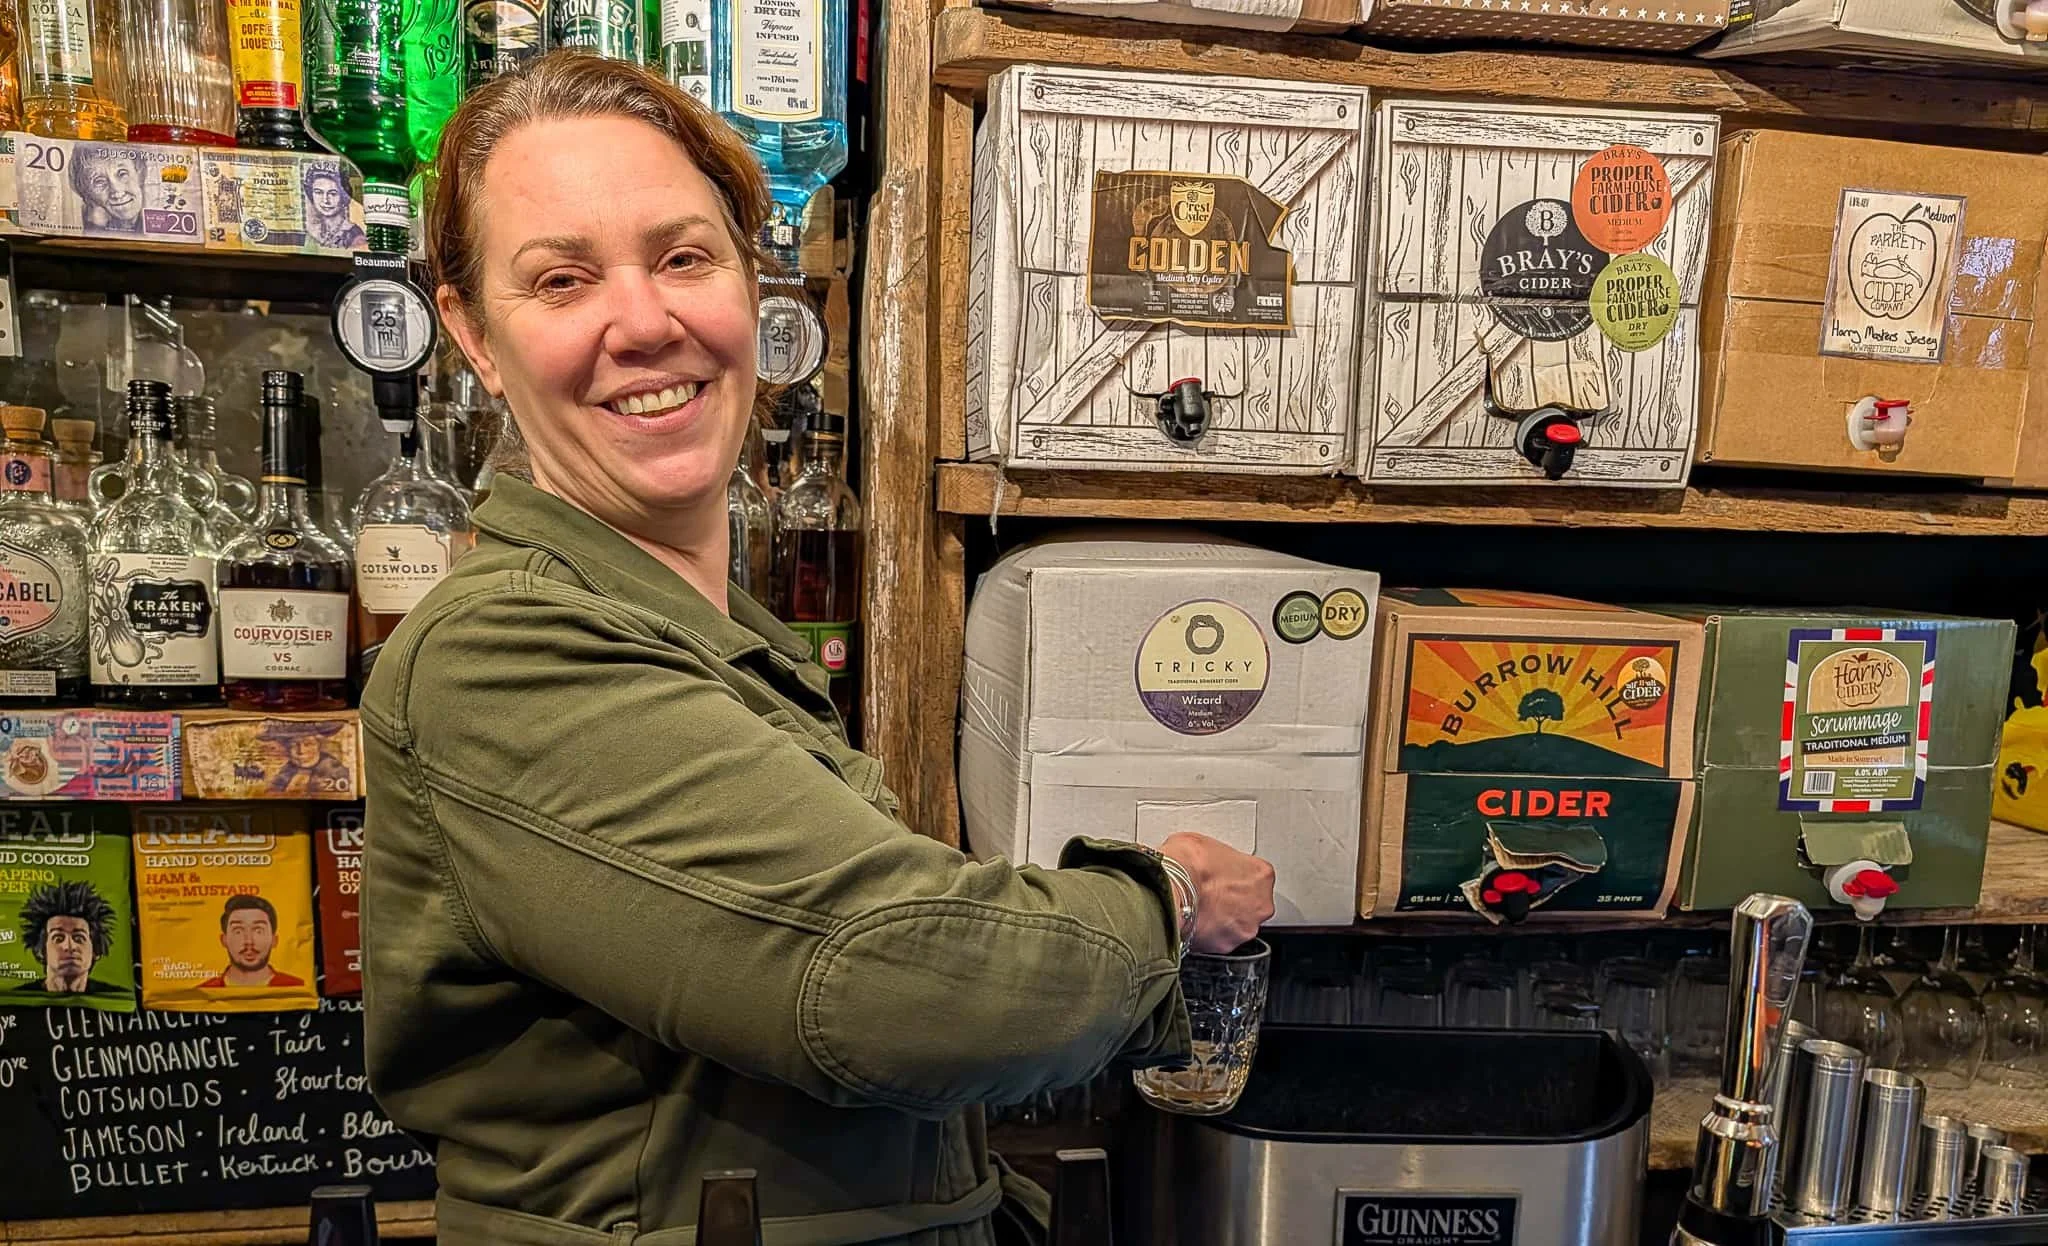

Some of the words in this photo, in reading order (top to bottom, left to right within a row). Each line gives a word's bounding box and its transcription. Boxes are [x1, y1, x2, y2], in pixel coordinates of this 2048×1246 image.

[754, 6, 777, 16] DRY
[778, 7, 801, 17] GIN
[756, 31, 800, 42] INFUSED
[771, 75, 785, 84] 1761
[23, 143, 65, 173] 20
[97, 148, 138, 162] TJUGO
[140, 151, 194, 165] KRONOR
[1603, 148, 1642, 161] BRAY'S
[1591, 165, 1655, 183] PROPER
[1591, 180, 1663, 195] FARMHOUSE
[1589, 192, 1651, 216] CIDER
[1541, 210, 1555, 232] B
[1606, 217, 1644, 227] MEDIUM
[1922, 205, 1957, 224] Medium
[168, 213, 196, 234] 20
[1891, 223, 1907, 233] THE
[209, 227, 225, 242] $2
[1870, 232, 1927, 251] PARRETT
[354, 256, 406, 269] Beaumont
[1128, 236, 1250, 274] GOLDEN
[1496, 248, 1594, 278] BRAY'S
[1615, 262, 1653, 276] BRAY'S
[1155, 273, 1185, 283] Medium
[1185, 274, 1200, 285] Dry
[1200, 275, 1224, 286] Cyder
[1519, 277, 1573, 290] CIDER
[1606, 274, 1663, 294] PROPER
[1606, 286, 1672, 306] FARMHOUSE
[1863, 280, 1914, 303] CIDER
[1606, 299, 1660, 323] CIDER
[1870, 301, 1904, 312] COMPANY
[372, 310, 397, 328] 25
[1628, 321, 1649, 332] DRY
[378, 329, 393, 342] ml
[770, 326, 792, 343] 25
[1832, 319, 1862, 344] Harry
[361, 564, 438, 574] COTSWOLDS
[159, 590, 180, 601] The
[133, 600, 202, 612] KRAKEN
[1324, 605, 1362, 622] DRY
[1279, 612, 1320, 624] MEDIUM
[233, 627, 333, 642] COURVOISIER
[273, 652, 293, 663] VS
[265, 665, 301, 673] COGNAC
[1154, 661, 1253, 673] TRICKY
[1833, 659, 1894, 689] Harry's
[1440, 653, 1574, 737] BURROW
[1580, 667, 1633, 741] HILL
[1622, 686, 1662, 700] CIDER
[1837, 682, 1879, 700] CIDER
[1181, 694, 1222, 705] Wizard
[1187, 709, 1213, 717] Medium
[1811, 710, 1903, 738] Scrummage
[1806, 739, 1869, 752] TRADITIONAL
[1870, 735, 1906, 746] MEDIUM
[1854, 768, 1871, 777] 6.0%
[1871, 768, 1889, 776] ABV
[323, 778, 349, 792] 20
[1476, 788, 1612, 818] CIDER
[0, 811, 85, 843] EAL
[145, 814, 267, 846] REAL
[21, 852, 90, 867] COOKED
[145, 855, 197, 868] HAND
[200, 854, 272, 867] COOKED
[145, 873, 185, 885] HAM
[188, 871, 201, 883] &
[182, 884, 260, 897] MUSTARD
[1597, 895, 1611, 903] 35
[1613, 895, 1643, 903] PINTS
[52, 1036, 240, 1083] GLENMORANGIE
[268, 1029, 326, 1056] Tain
[60, 1079, 223, 1121] COTSWOLDS
[61, 1118, 186, 1161] JAMESON
[218, 1112, 310, 1148] Ireland
[341, 1110, 396, 1140] Blen
[69, 1160, 190, 1194] BULLET
[220, 1152, 320, 1180] Kentuck
[1356, 1202, 1501, 1237] GUINNESS
[1396, 1237, 1460, 1246] DRAUGHT
